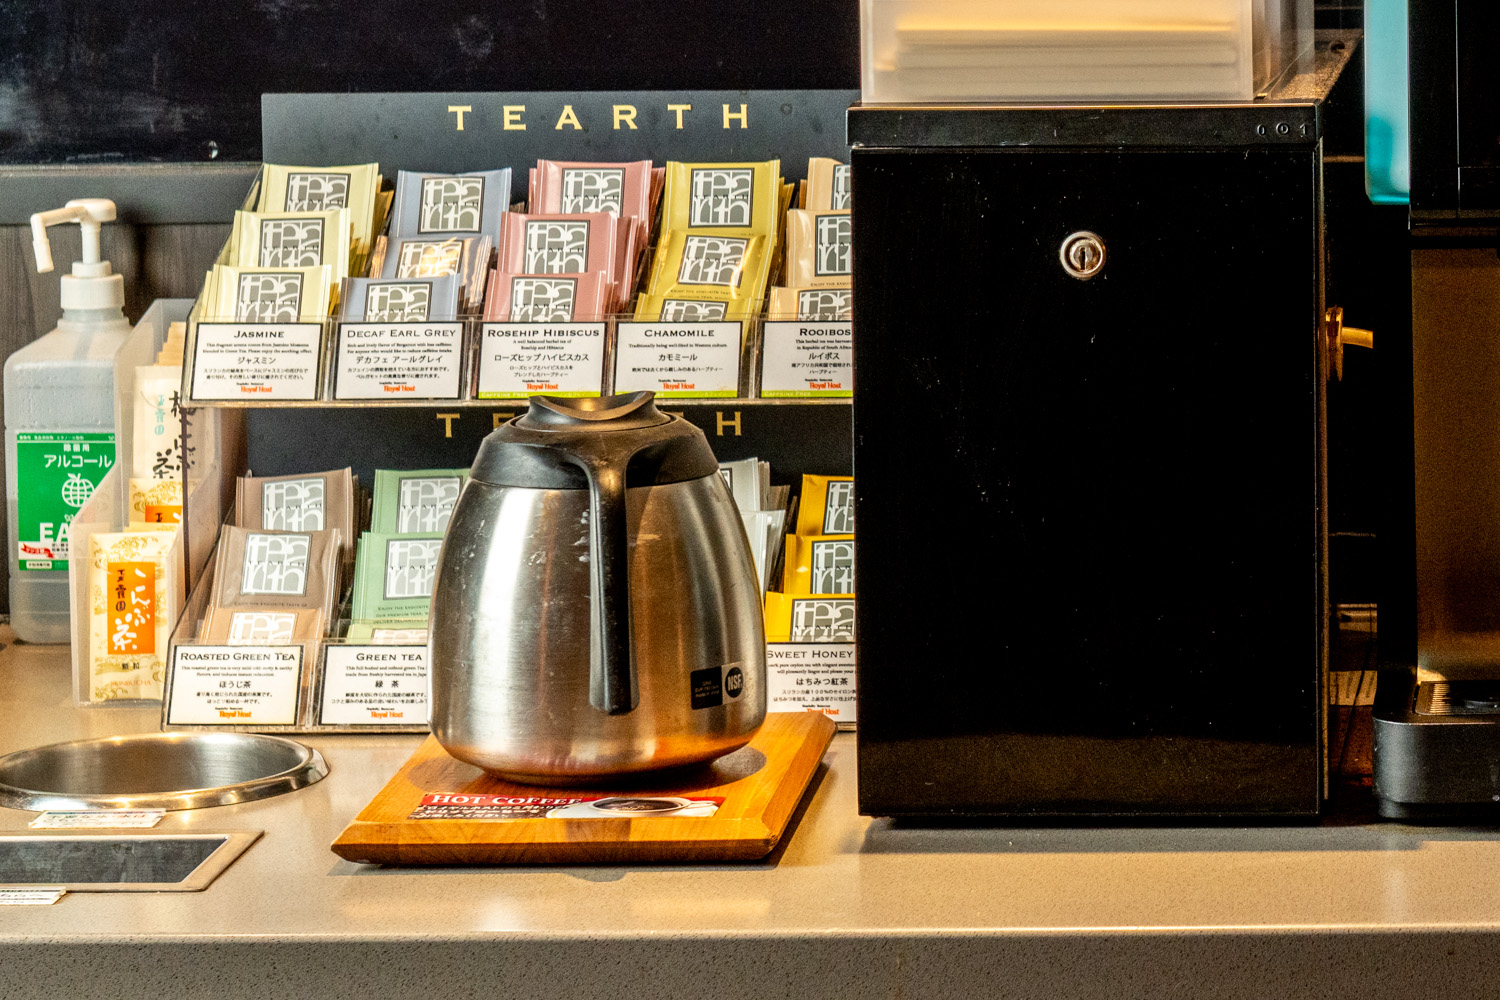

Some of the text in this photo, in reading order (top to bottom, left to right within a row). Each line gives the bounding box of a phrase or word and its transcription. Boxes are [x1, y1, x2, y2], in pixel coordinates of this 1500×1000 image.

[448, 103, 749, 131] TEARTH
[234, 330, 285, 339] JASMINE
[347, 328, 456, 339] DECAF EARL GREY
[488, 328, 600, 338] ROSEHIP HIBISCUS
[644, 329, 715, 338] CHAMOMILE
[799, 328, 852, 337] ROOIBOS
[237, 356, 277, 365] ジャスミン
[356, 355, 444, 365] デカフェ アールグレイ
[658, 353, 698, 362] カモミール
[808, 352, 841, 361] ルイボス
[384, 385, 401, 393] Royal
[527, 383, 544, 391] Royal
[663, 383, 680, 391] Royal
[809, 382, 827, 390] Royal
[43, 454, 113, 468] アルコール
[180, 652, 296, 661] ROASTED GREEN TEA
[356, 653, 423, 661] GREEN TEA
[767, 650, 854, 659] SWEET HONEY
[219, 680, 252, 690] ほうじ茶
[796, 677, 849, 686] はちみつ紅茶
[219, 711, 237, 719] Royal
[370, 711, 389, 720] Royal
[432, 794, 583, 806] HOT COFFEE
